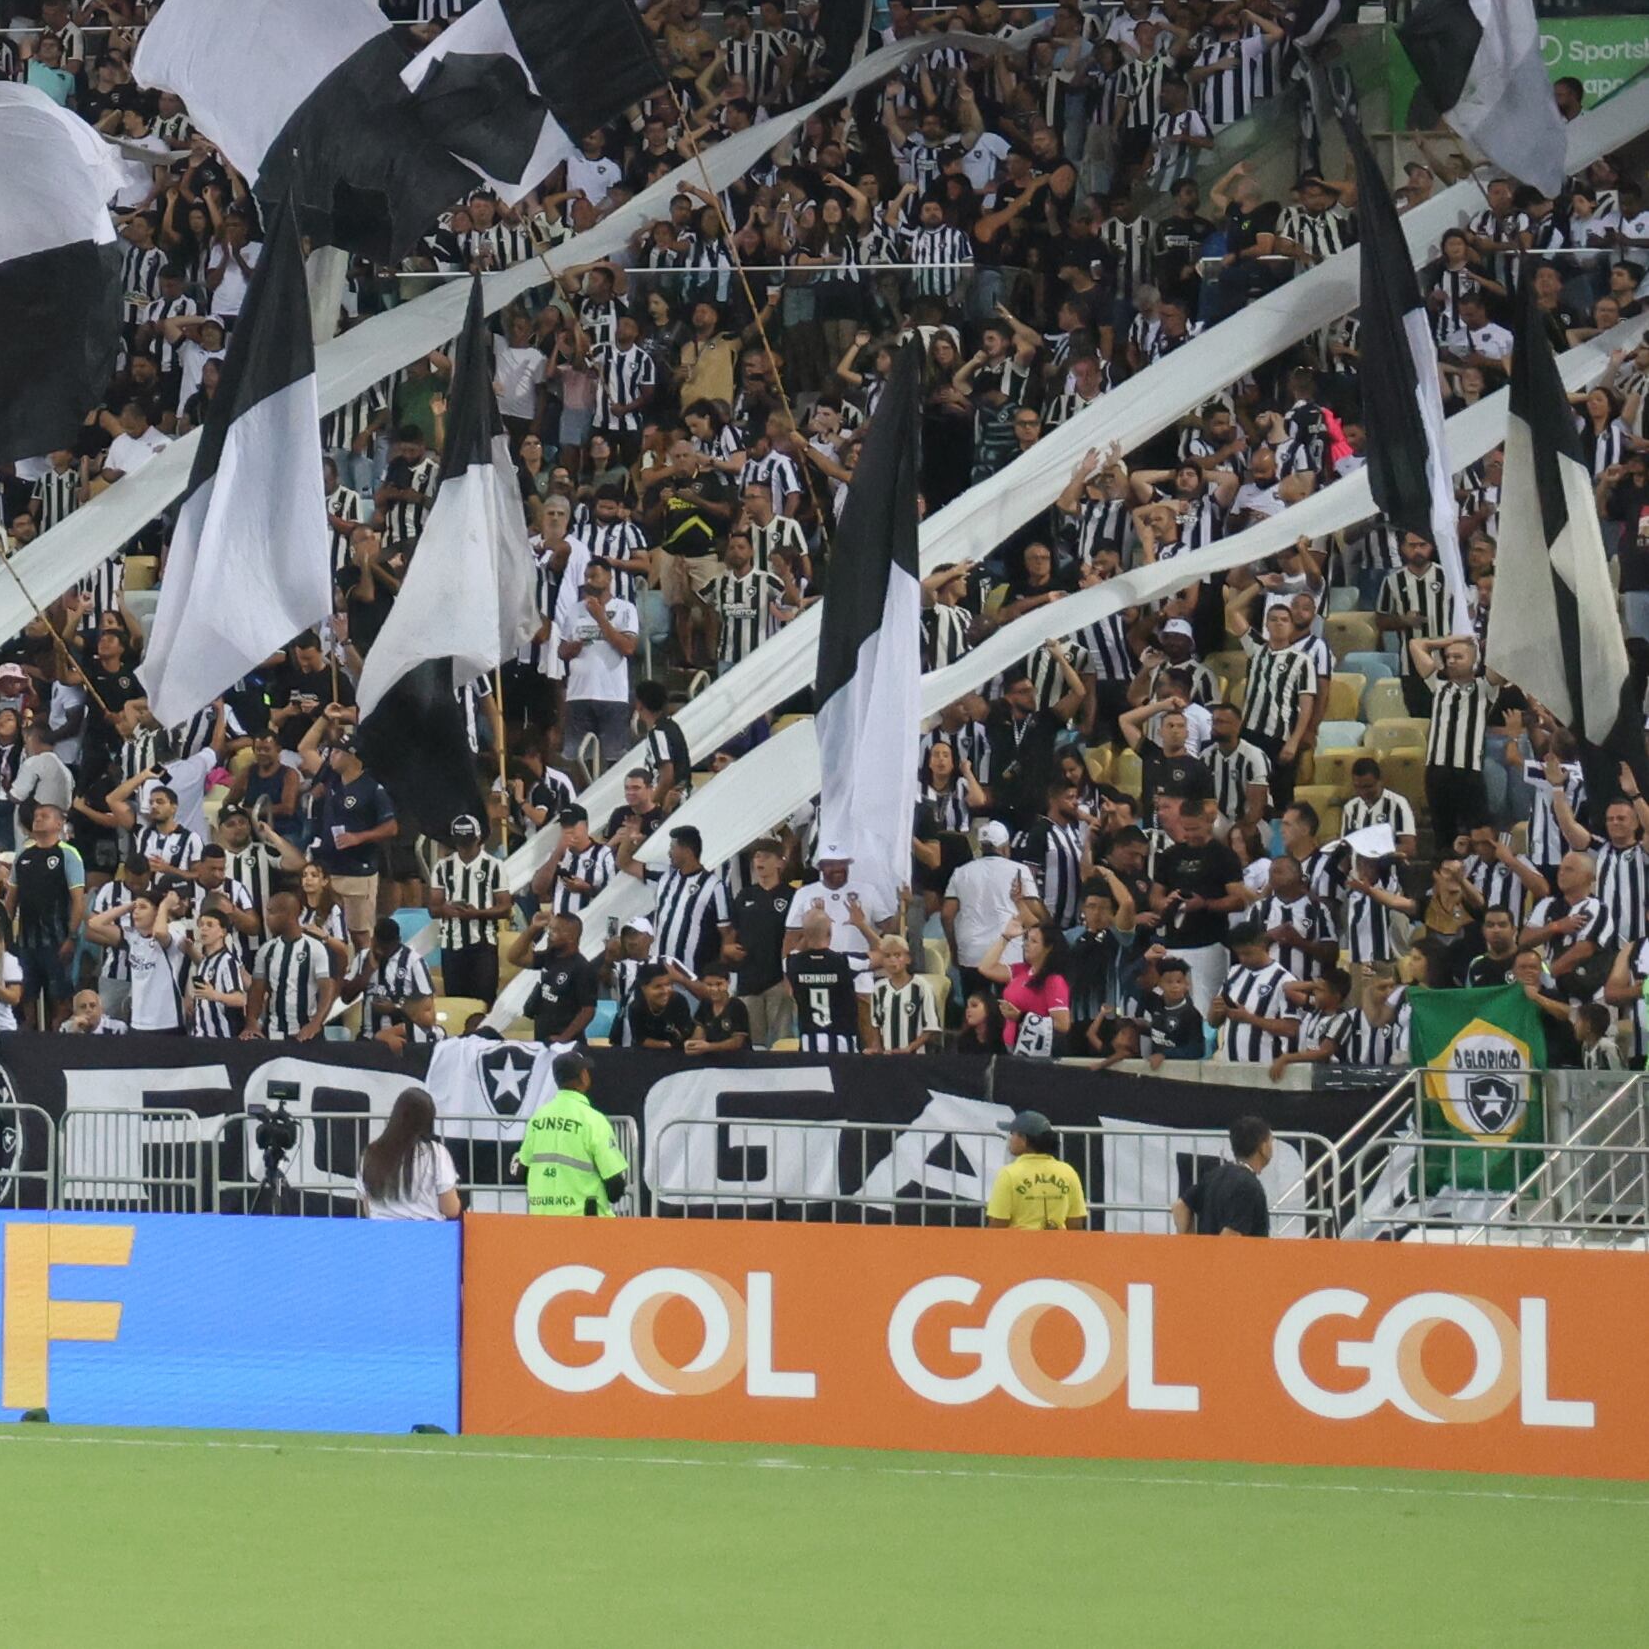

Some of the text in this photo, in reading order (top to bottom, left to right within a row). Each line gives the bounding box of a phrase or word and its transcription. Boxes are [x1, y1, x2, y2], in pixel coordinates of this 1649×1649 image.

[809, 988, 832, 1027] 9
[532, 1116, 583, 1135] SUNSET
[514, 1265, 816, 1398] GOL
[888, 1275, 1199, 1411] GOL
[1273, 1288, 1595, 1427] GOL
